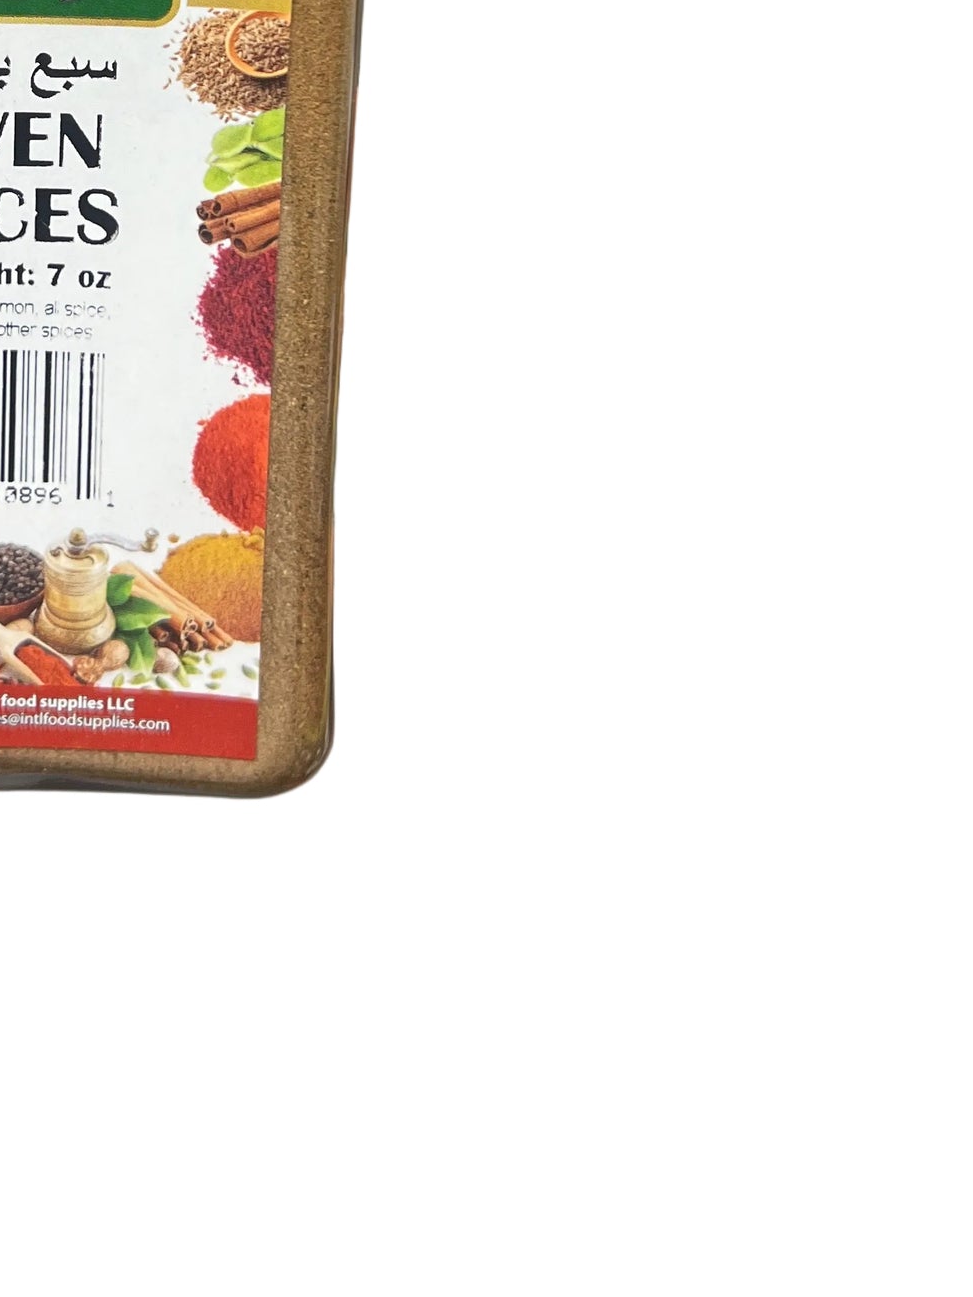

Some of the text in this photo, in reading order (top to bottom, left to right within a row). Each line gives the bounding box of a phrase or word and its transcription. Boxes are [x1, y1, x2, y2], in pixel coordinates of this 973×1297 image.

[30, 52, 117, 98] سبع
[47, 263, 65, 286] 7
[78, 269, 111, 288] oz
[107, 490, 114, 507] 1
[1, 694, 37, 707] food
[40, 696, 104, 710] supplies
[107, 697, 134, 710] LLC
